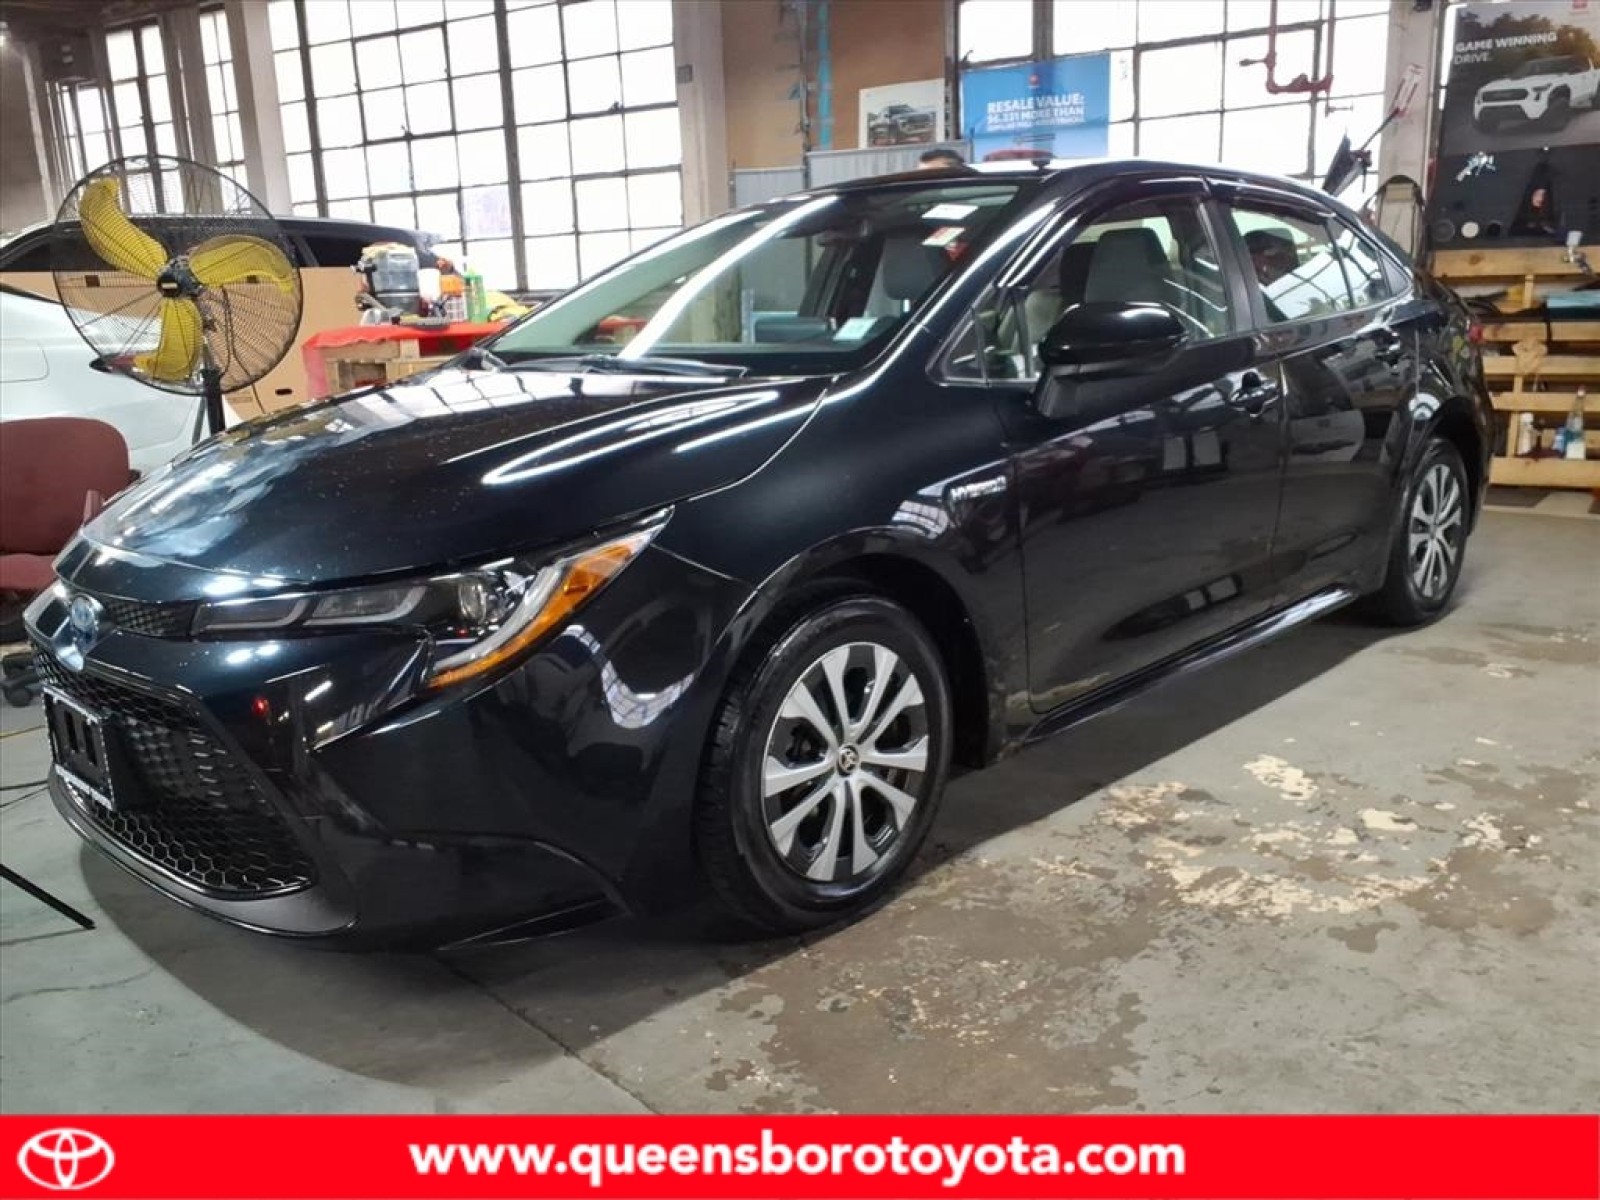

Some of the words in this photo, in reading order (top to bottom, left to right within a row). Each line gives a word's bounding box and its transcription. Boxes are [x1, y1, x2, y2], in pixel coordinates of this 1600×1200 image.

[1455, 39, 1493, 52] GAME
[1495, 31, 1557, 48] WINNING
[986, 97, 1034, 113] RESALE
[1053, 105, 1085, 118] THAN
